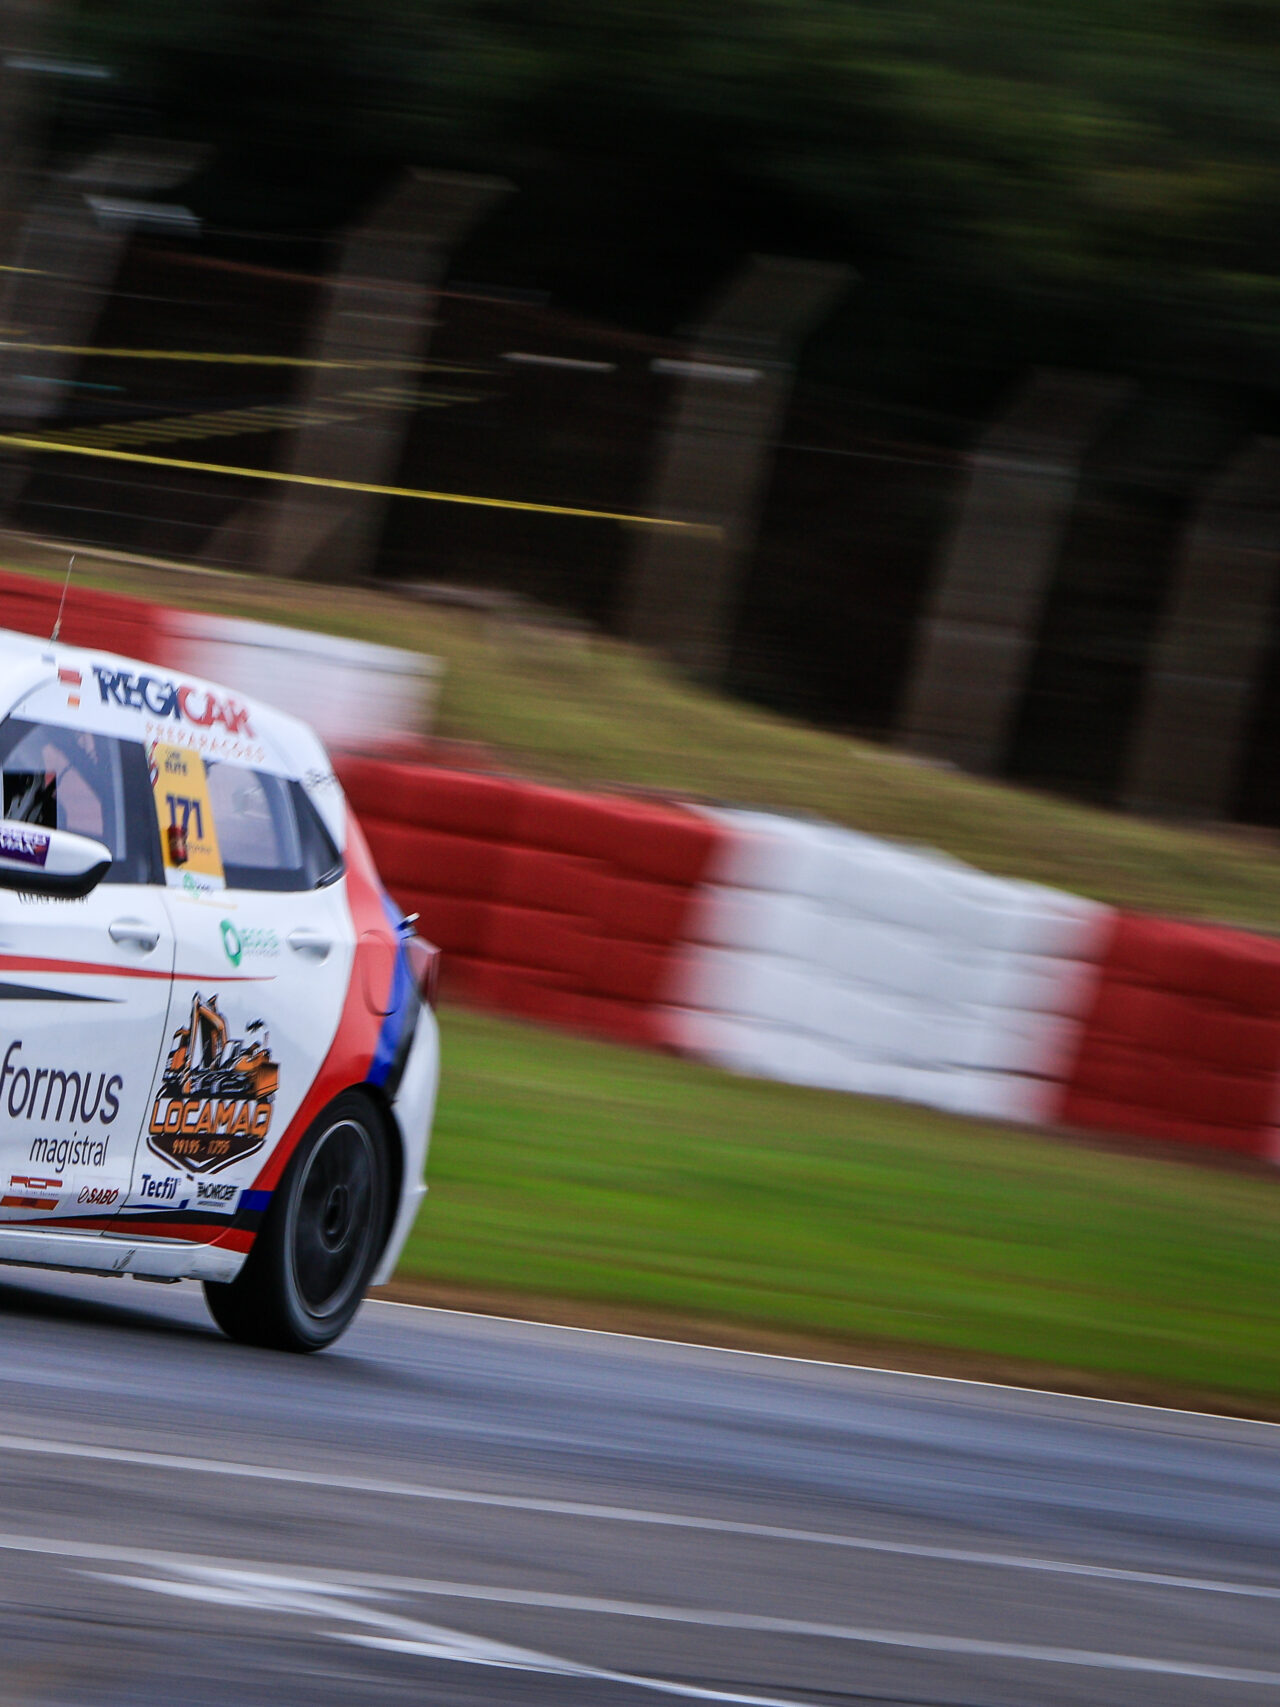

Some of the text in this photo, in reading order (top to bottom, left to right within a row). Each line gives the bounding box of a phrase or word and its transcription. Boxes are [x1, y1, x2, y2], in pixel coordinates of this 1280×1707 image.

[166, 794, 204, 840] 171
[149, 1099, 272, 1139] LOCAMAQ
[29, 1131, 111, 1173] magistral
[140, 1174, 178, 1199] Tecfil
